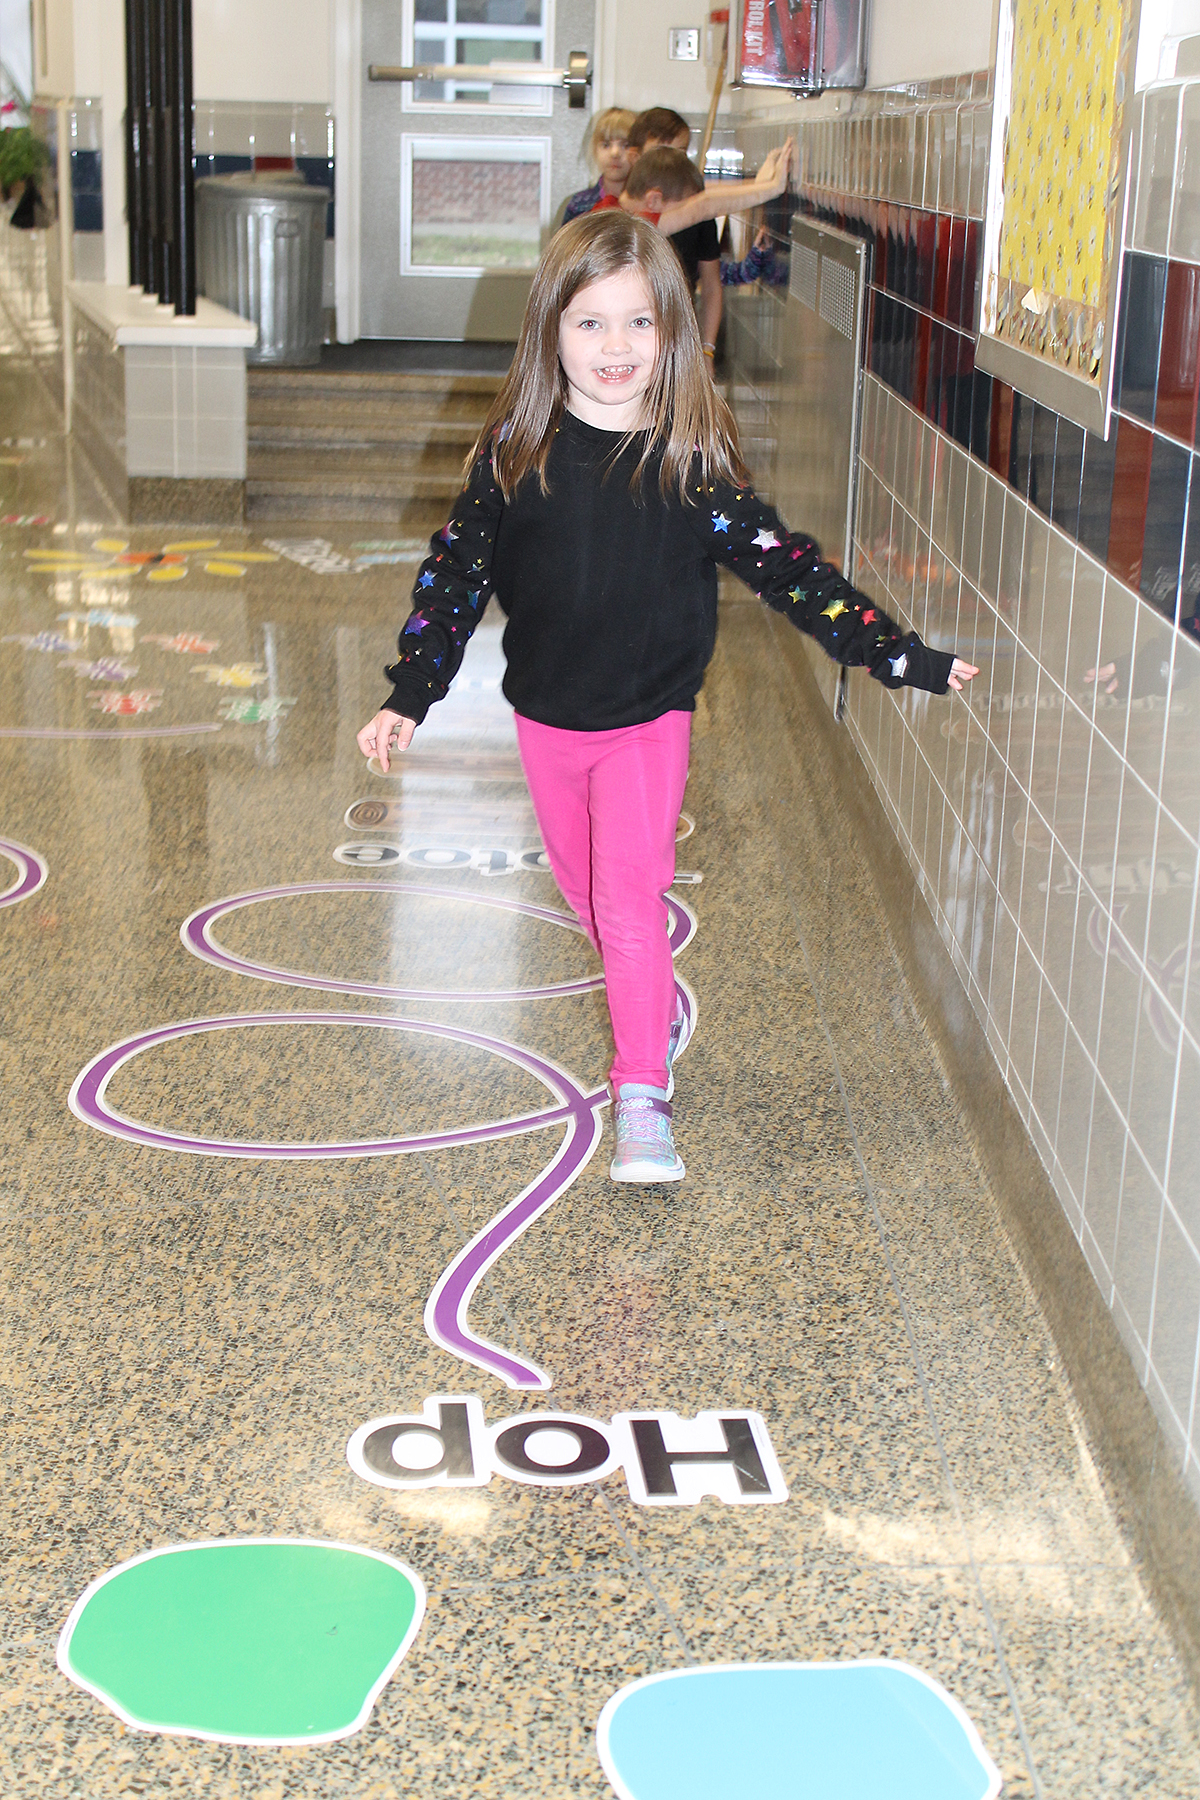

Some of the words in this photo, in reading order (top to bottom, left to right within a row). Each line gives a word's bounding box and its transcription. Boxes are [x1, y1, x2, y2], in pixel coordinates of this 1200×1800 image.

[748, 0, 765, 28] ROL
[744, 30, 764, 56] KIT
[363, 1402, 772, 1497] Hop
